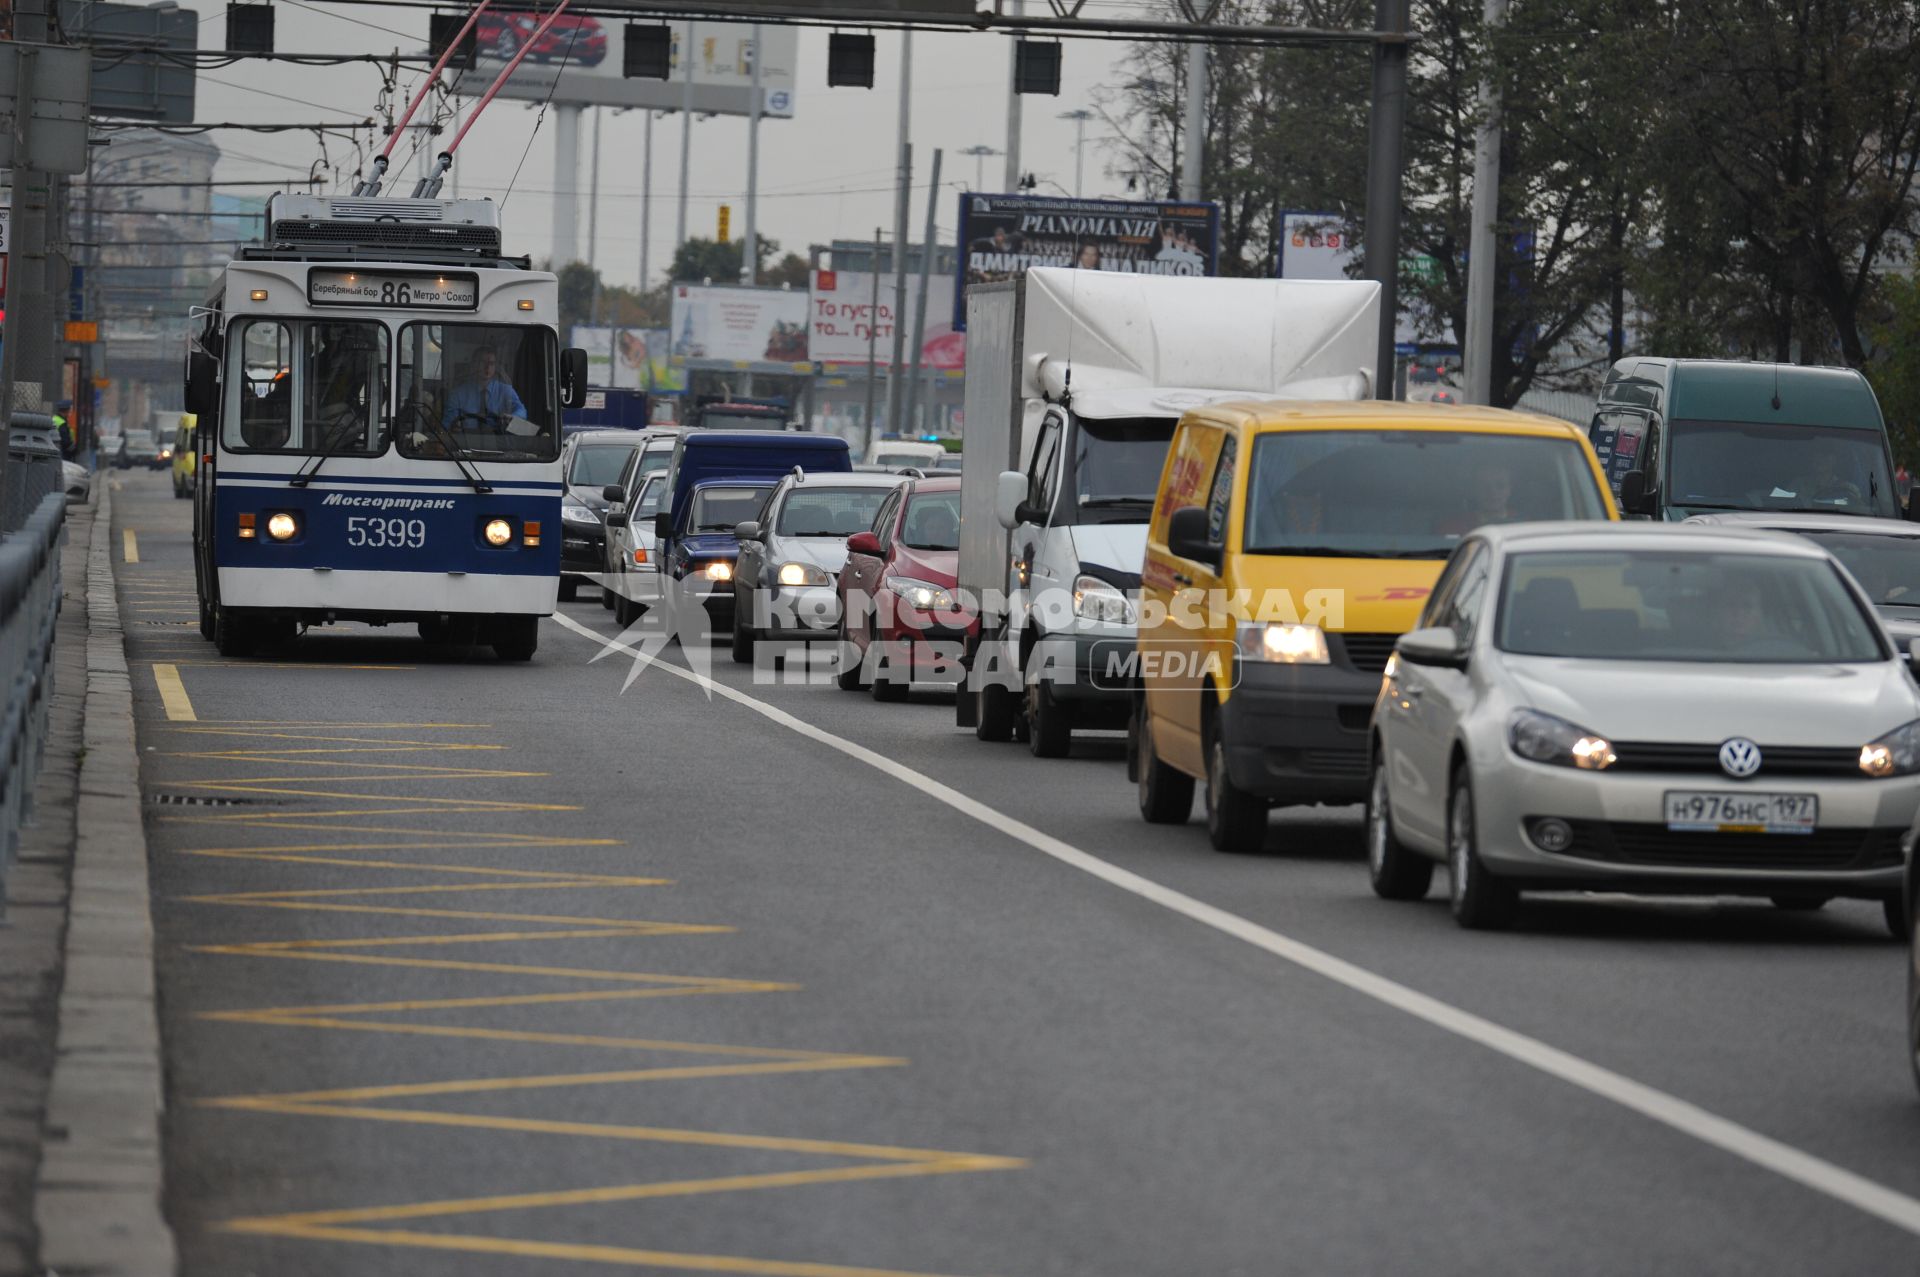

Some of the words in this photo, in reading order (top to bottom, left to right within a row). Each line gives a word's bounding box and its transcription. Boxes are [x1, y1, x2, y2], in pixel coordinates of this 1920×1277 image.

[313, 282, 362, 296] Серебряный
[364, 287, 378, 298] бор
[381, 281, 411, 304] 86
[414, 289, 440, 300] Метро
[816, 299, 836, 317] То
[321, 493, 456, 511] Мосгортранс
[348, 516, 426, 548] 5399
